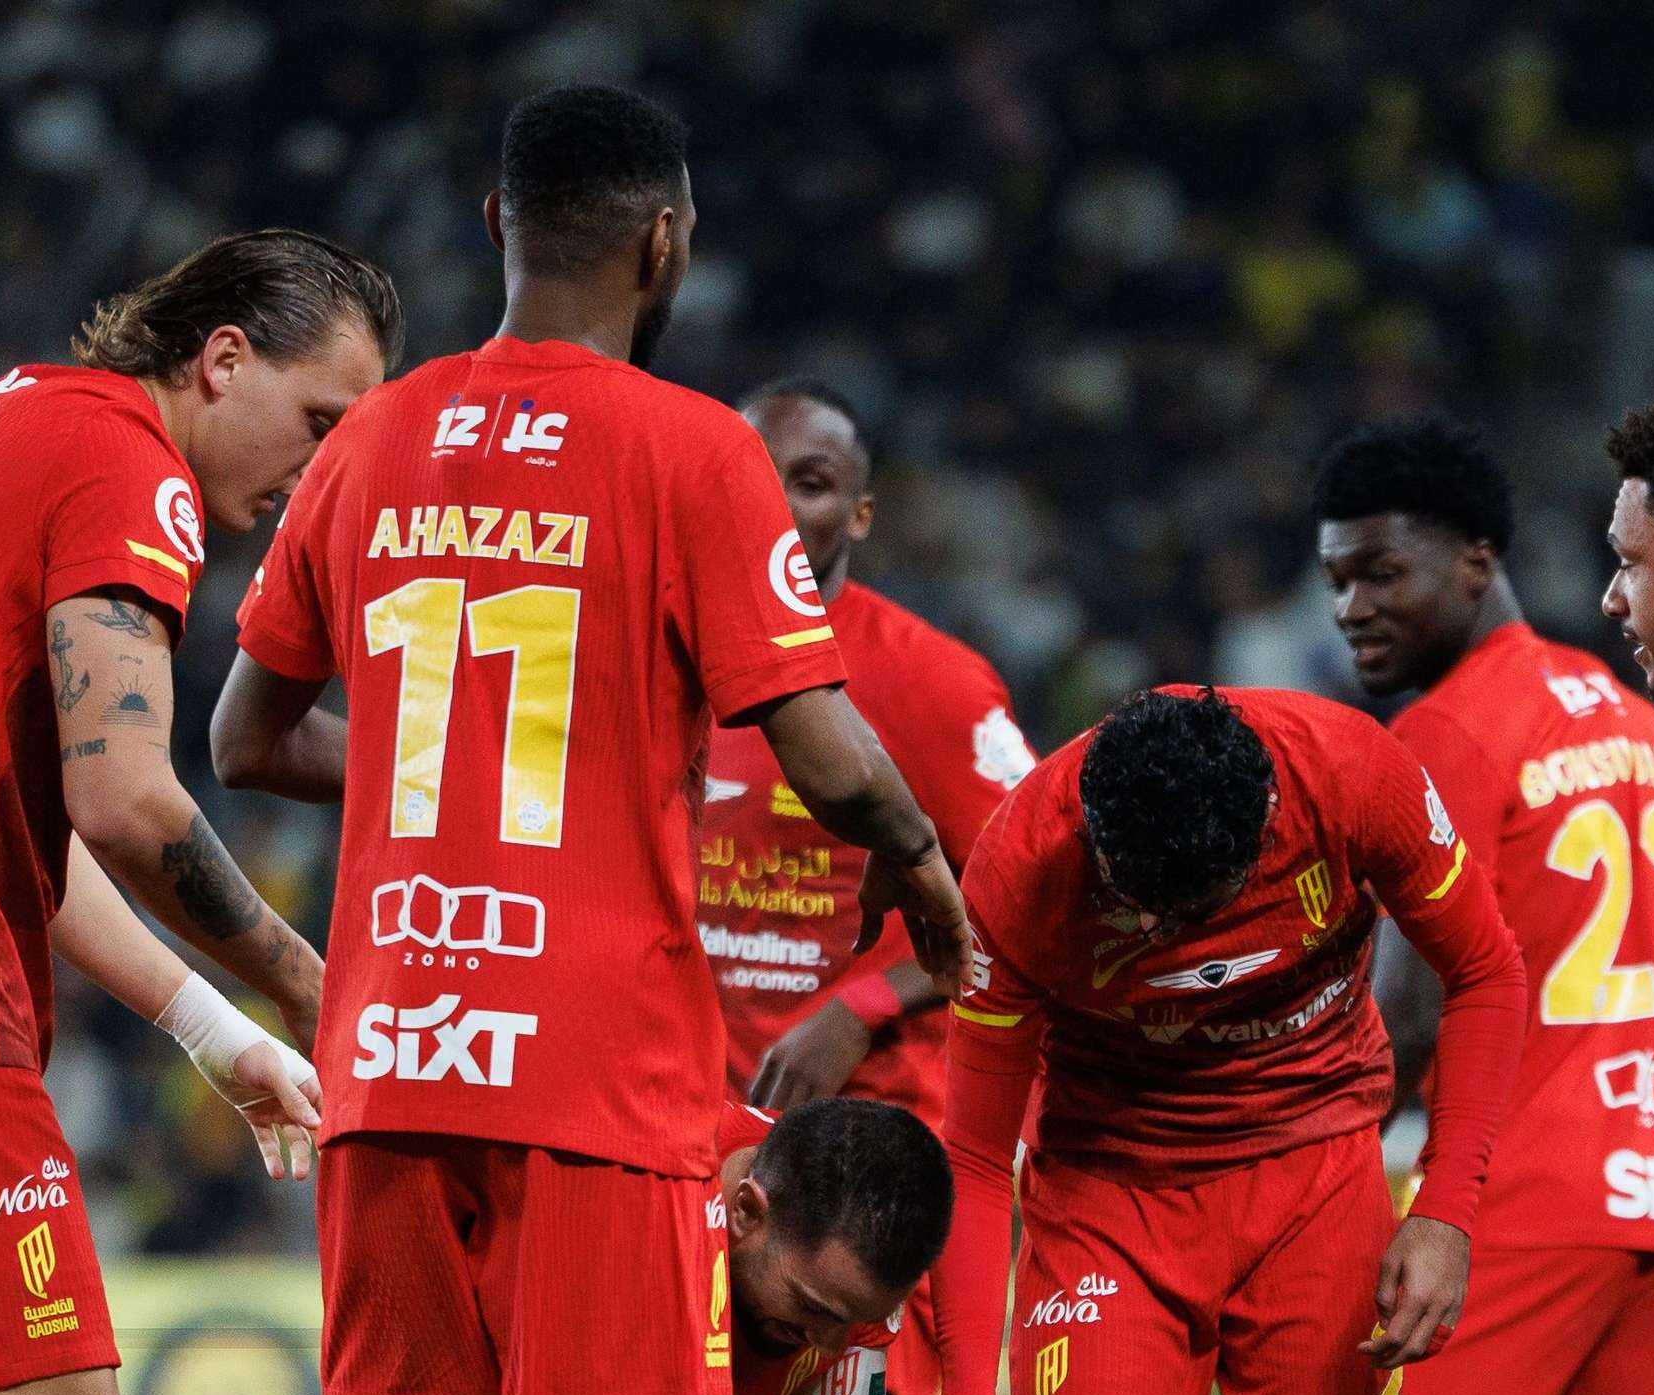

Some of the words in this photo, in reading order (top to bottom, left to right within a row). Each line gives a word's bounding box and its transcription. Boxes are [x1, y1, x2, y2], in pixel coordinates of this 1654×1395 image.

[367, 505, 589, 567] A.HAZAZI
[364, 577, 581, 848] 11
[725, 880, 835, 916] Aviation
[403, 952, 480, 970] ZOHO
[23, 1297, 75, 1321] القادسية
[27, 1316, 79, 1339] QADSIAH
